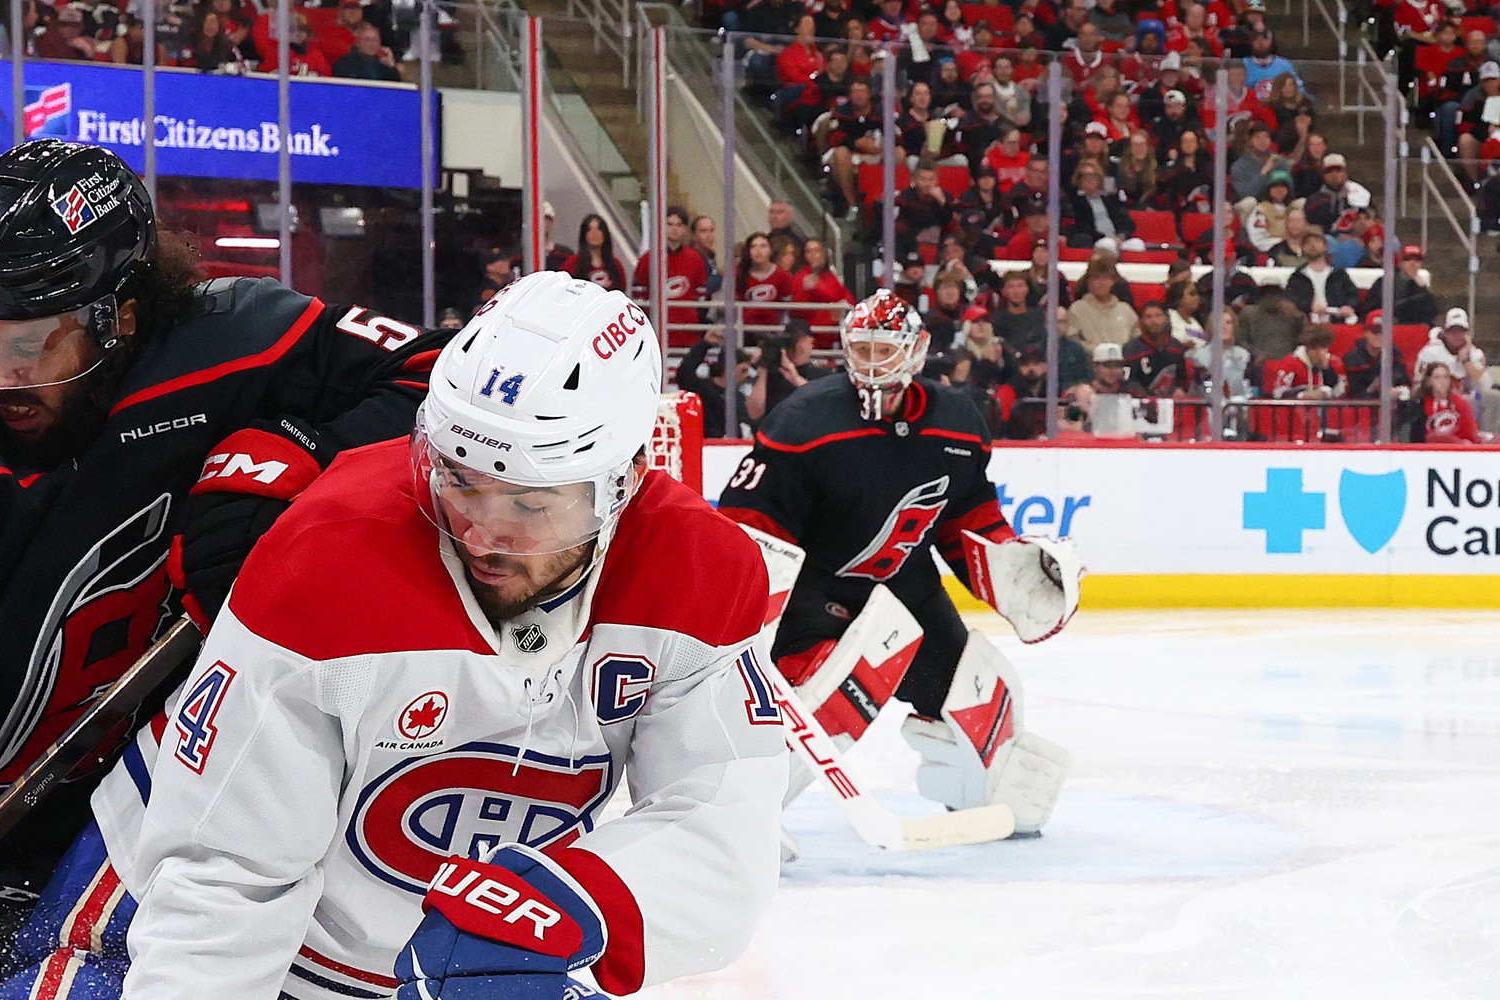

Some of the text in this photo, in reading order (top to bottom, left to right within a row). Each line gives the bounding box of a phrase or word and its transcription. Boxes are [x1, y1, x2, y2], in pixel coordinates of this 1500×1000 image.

[76, 171, 103, 192] First
[87, 180, 120, 203] Citizens
[95, 194, 121, 218] Bank
[336, 304, 422, 352] 5
[592, 313, 637, 361] CIBC
[479, 366, 527, 407] 14
[858, 388, 882, 421] 31
[119, 413, 208, 443] NUCOR
[280, 419, 317, 451] CHATFIELD
[730, 457, 767, 490] 31
[1427, 468, 1500, 509] No
[1426, 515, 1500, 556] Ca
[592, 652, 657, 726] C
[845, 678, 881, 717] TRUE
[375, 739, 444, 750] AIR CANADA
[32, 772, 55, 796] sigma
